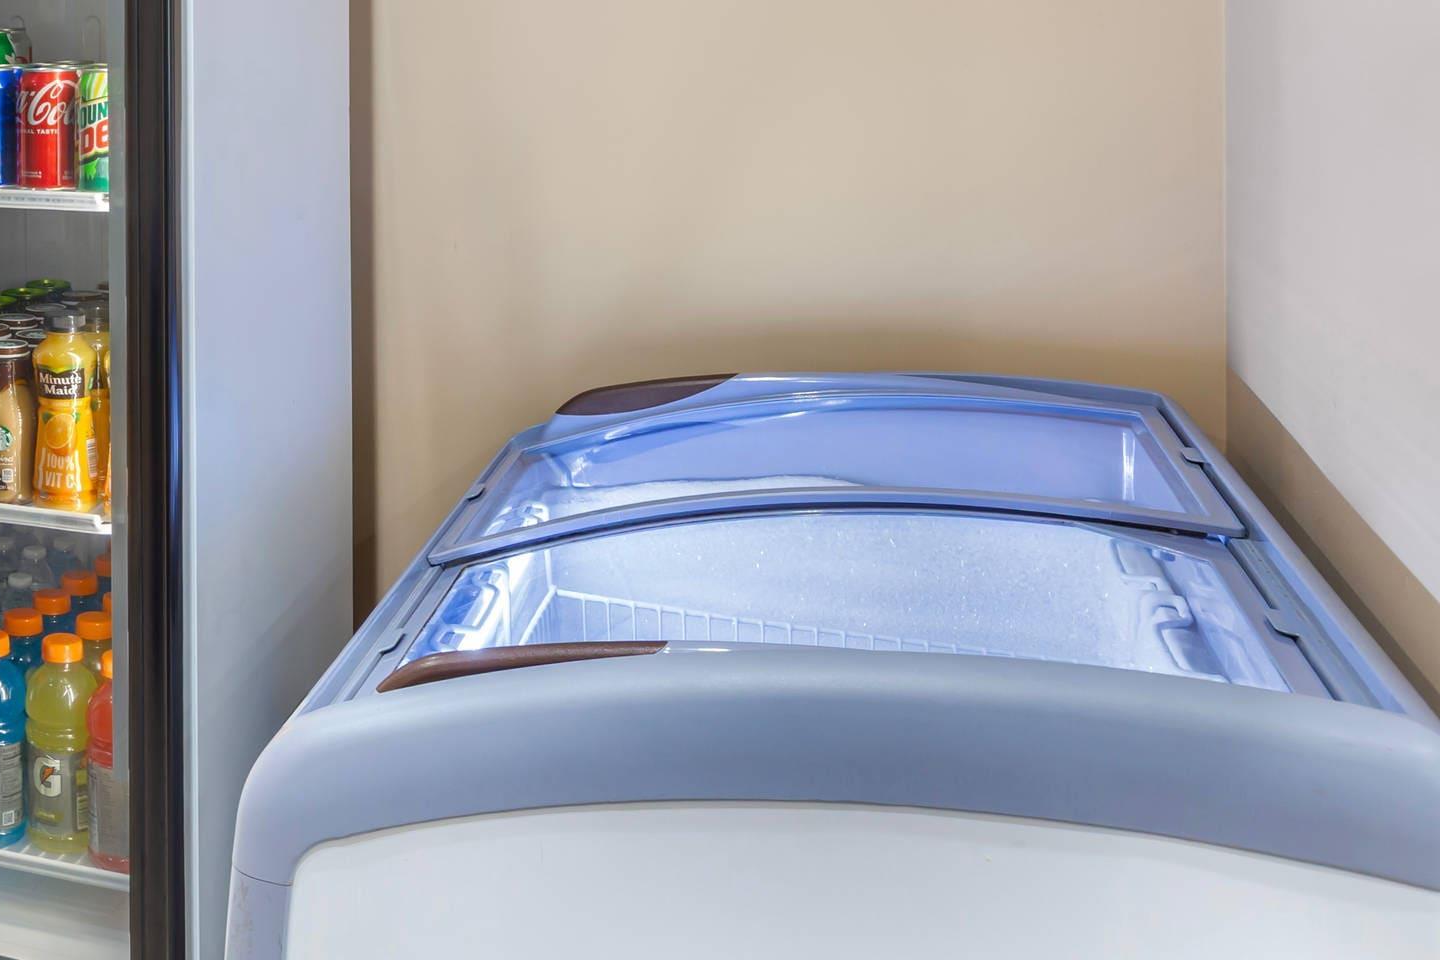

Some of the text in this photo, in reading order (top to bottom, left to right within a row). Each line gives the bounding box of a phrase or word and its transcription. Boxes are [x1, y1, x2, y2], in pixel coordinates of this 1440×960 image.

[81, 120, 109, 155] DE
[40, 372, 82, 385] Minute
[44, 383, 76, 395] Maid
[47, 454, 74, 470] 100%
[45, 471, 74, 489] VIT C
[34, 757, 61, 797] G
